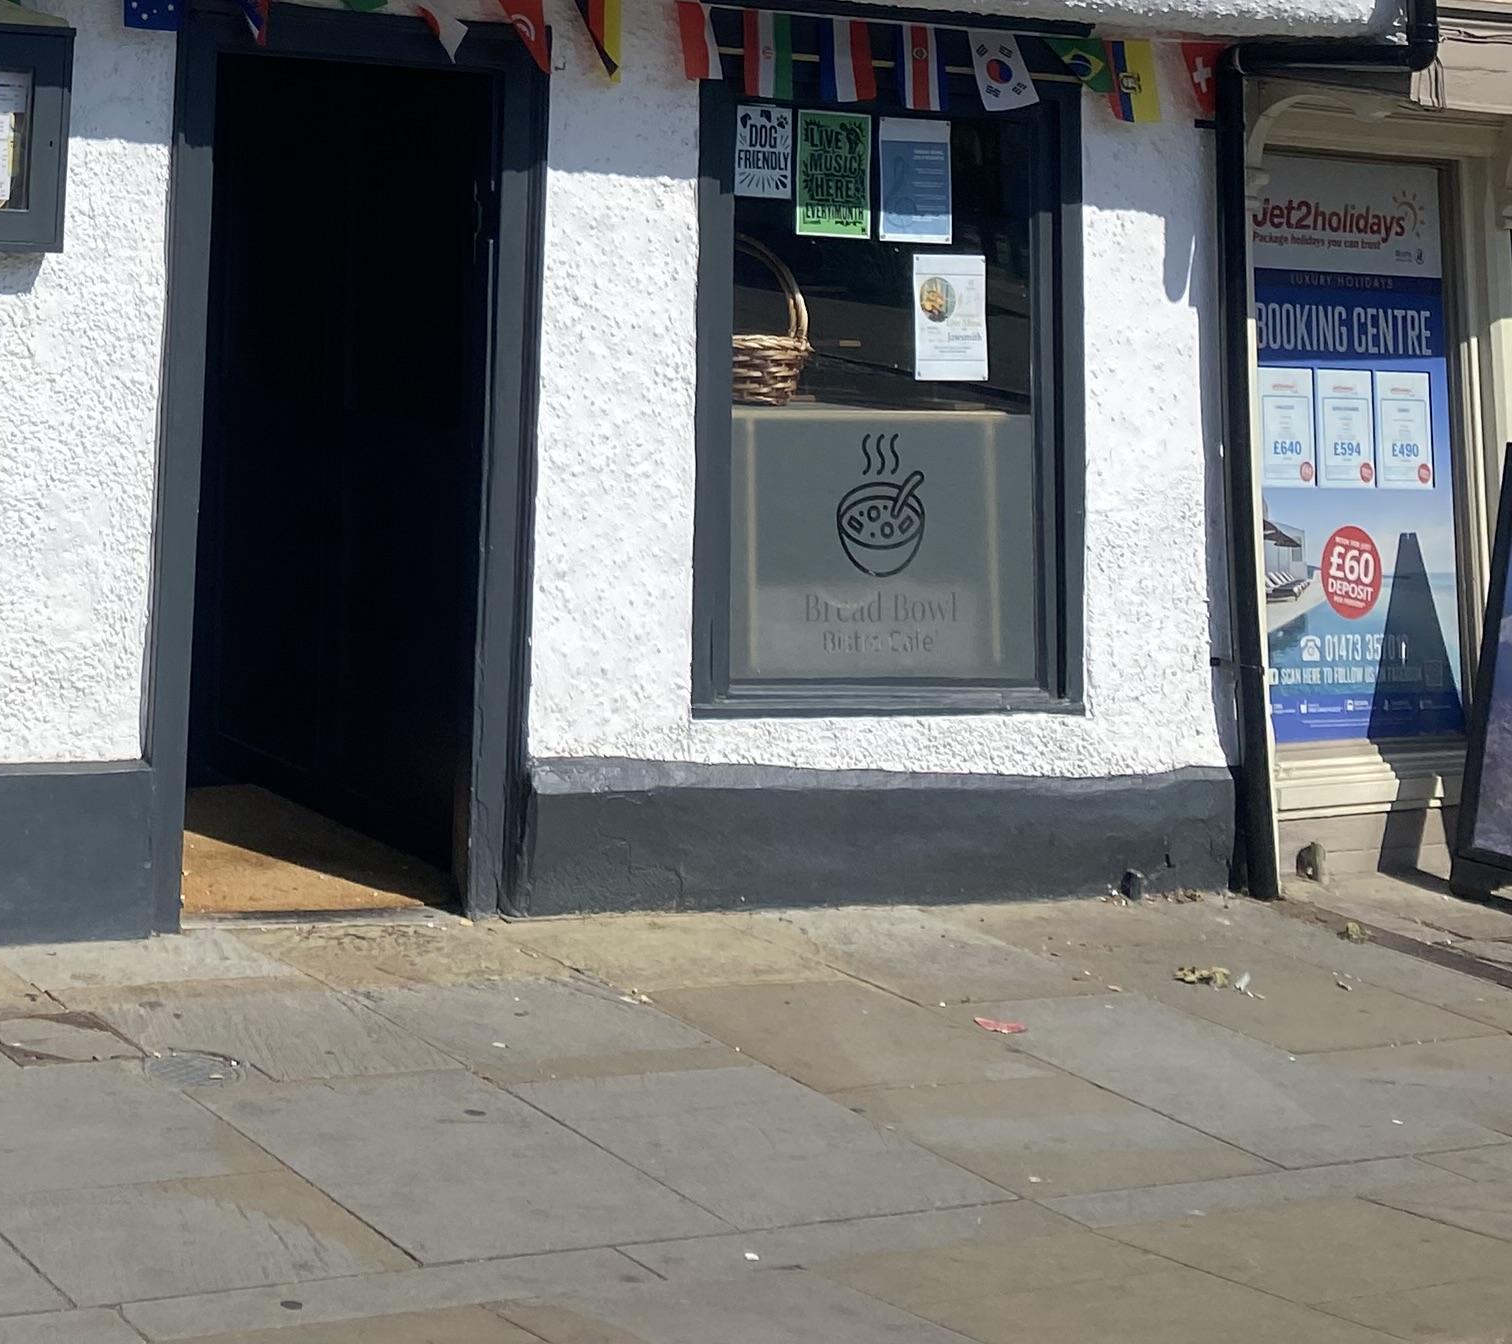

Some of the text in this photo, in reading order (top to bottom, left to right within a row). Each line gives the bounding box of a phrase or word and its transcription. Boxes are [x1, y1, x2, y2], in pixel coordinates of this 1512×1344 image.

[749, 124, 778, 149] DOG
[809, 126, 843, 151] LIVE
[737, 149, 790, 171] FRIENDLY
[809, 152, 859, 175] MUSIC
[813, 176, 855, 200] HERE
[1253, 197, 1406, 244] Jet2holidays
[1253, 231, 1382, 251] Package holidays you can trust
[1338, 275, 1393, 290] HOLIDAYS
[1256, 302, 1433, 356] BOOKING CENTRE
[1273, 441, 1302, 456] £640
[1333, 442, 1361, 456] £594
[1391, 443, 1420, 458] £490
[1329, 545, 1375, 584] £60
[1328, 578, 1374, 601] DEPOSIT
[804, 590, 959, 623] Bread Bowl
[1324, 633, 1362, 662] 01473
